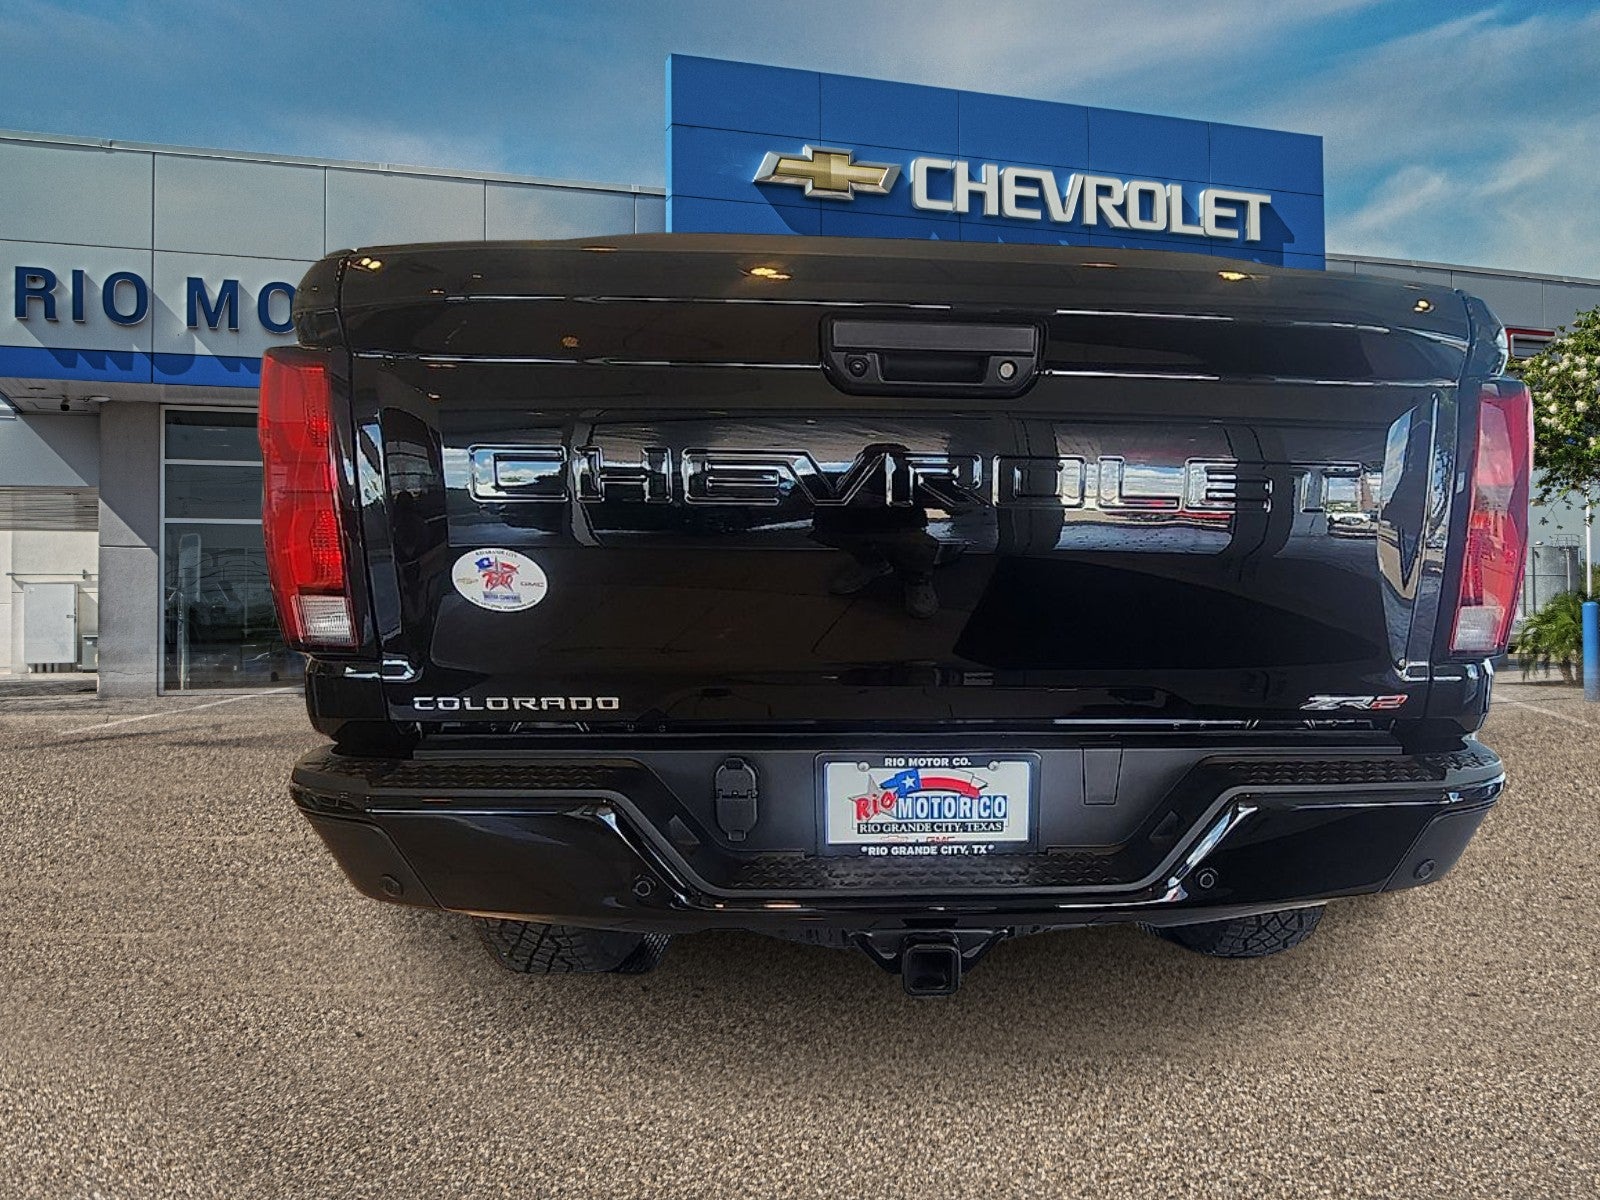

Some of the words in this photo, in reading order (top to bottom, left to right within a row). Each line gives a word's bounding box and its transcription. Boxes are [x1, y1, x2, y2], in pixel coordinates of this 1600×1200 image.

[911, 157, 1271, 242] CHEVROLET
[14, 265, 150, 326] RIO
[467, 443, 1363, 514] CHEVROLET
[413, 696, 620, 710] COLORADO
[1300, 694, 1408, 710] ZR2
[884, 757, 905, 766] RIO
[908, 757, 949, 766] MOTOR
[952, 757, 972, 766] CO.
[898, 797, 973, 819] MOTOR
[978, 796, 1006, 818] CO
[859, 823, 881, 833] RIO
[882, 823, 931, 833] GRANDE
[933, 823, 963, 833] CITY,
[966, 822, 1002, 832] TEXAS
[891, 846, 937, 855] GRANDE
[940, 845, 969, 855] CITY,
